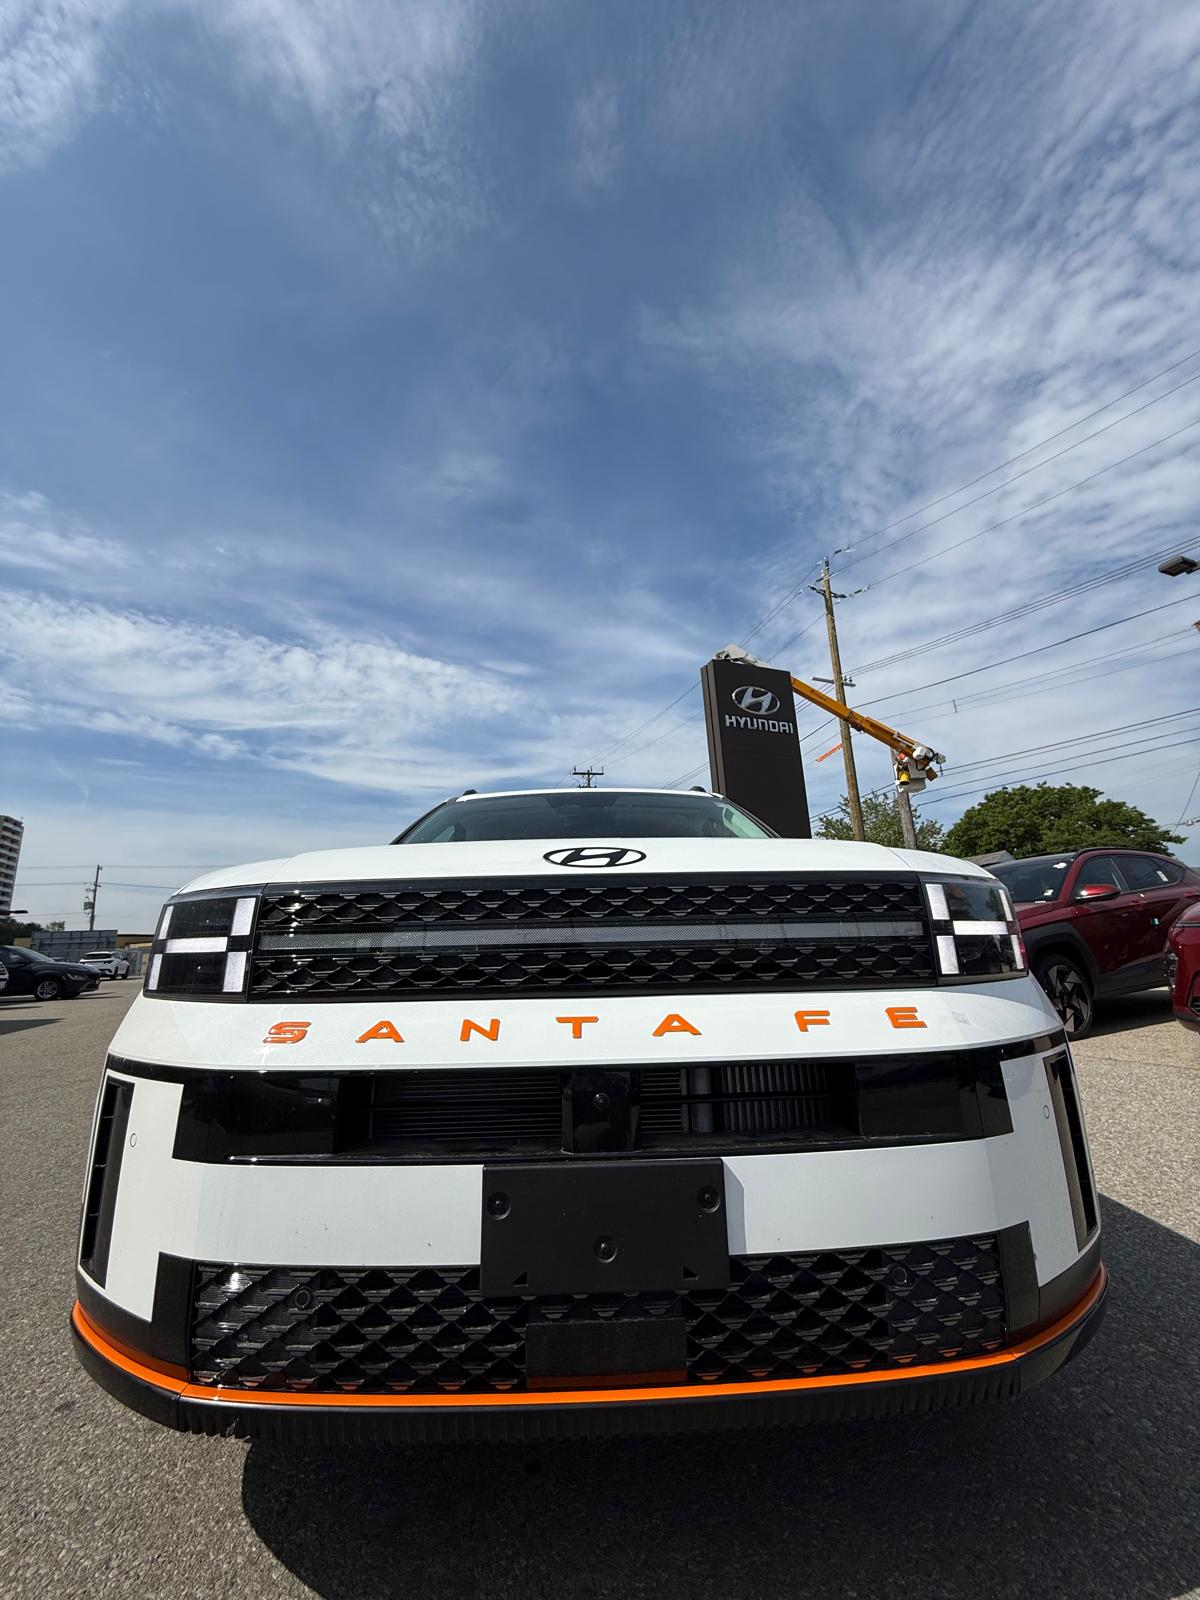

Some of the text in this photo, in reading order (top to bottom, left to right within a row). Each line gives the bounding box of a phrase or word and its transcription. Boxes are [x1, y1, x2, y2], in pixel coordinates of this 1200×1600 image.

[724, 714, 794, 735] HYUNDAI
[262, 1006, 928, 1044] SANTA FE
